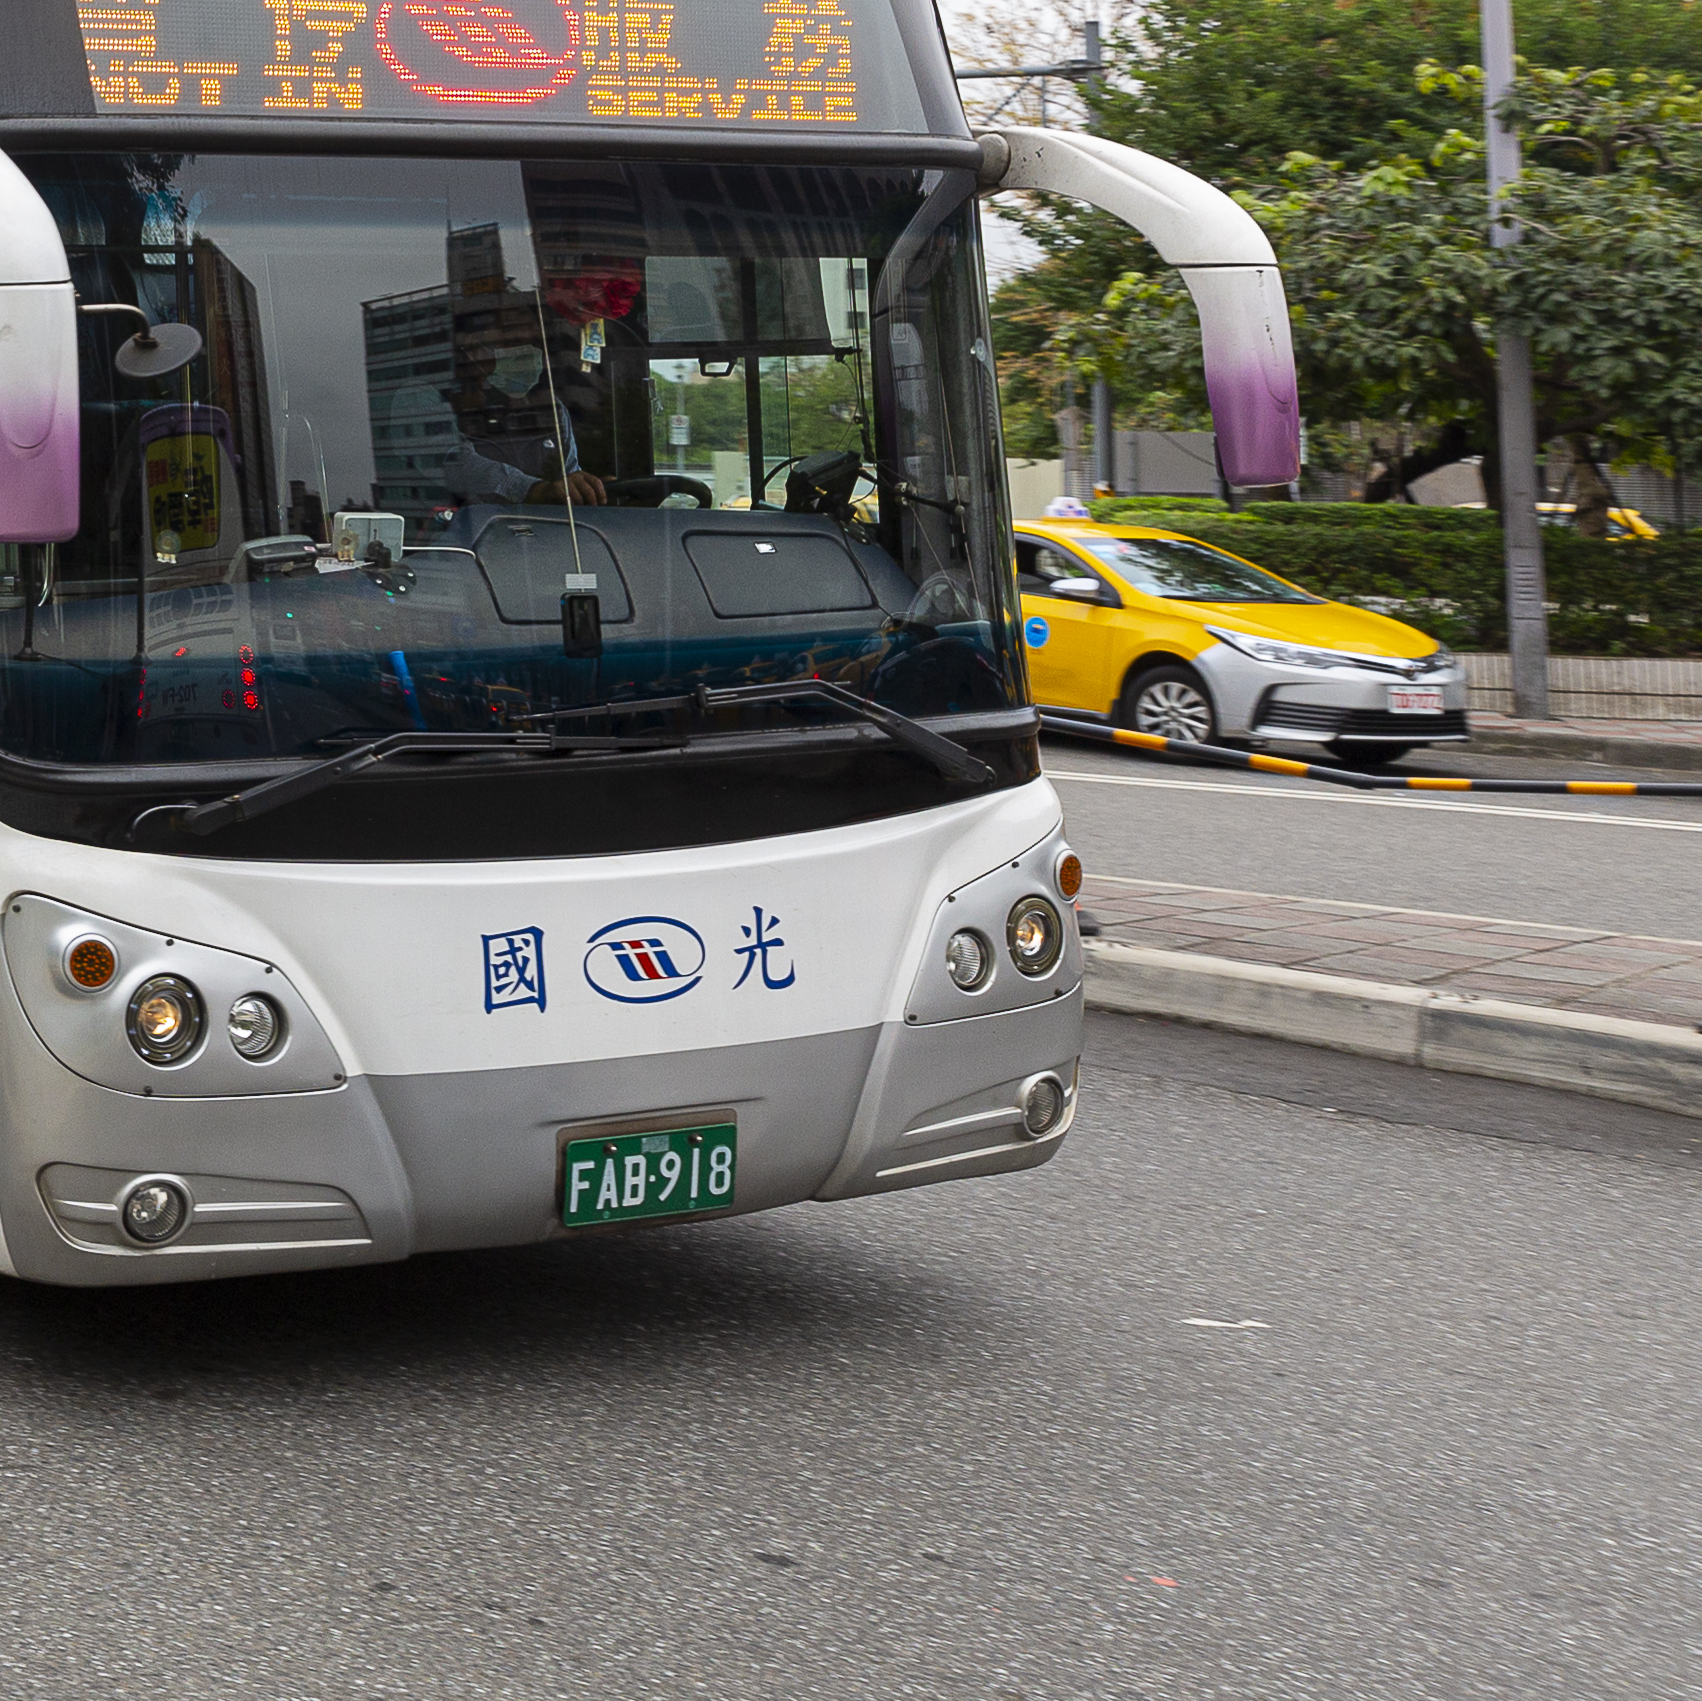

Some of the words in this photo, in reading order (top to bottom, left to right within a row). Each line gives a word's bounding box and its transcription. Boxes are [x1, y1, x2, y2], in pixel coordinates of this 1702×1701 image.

[263, 64, 363, 109] IN
[587, 75, 857, 121] SERVICE
[481, 926, 547, 1015] 國
[731, 905, 796, 991] 光
